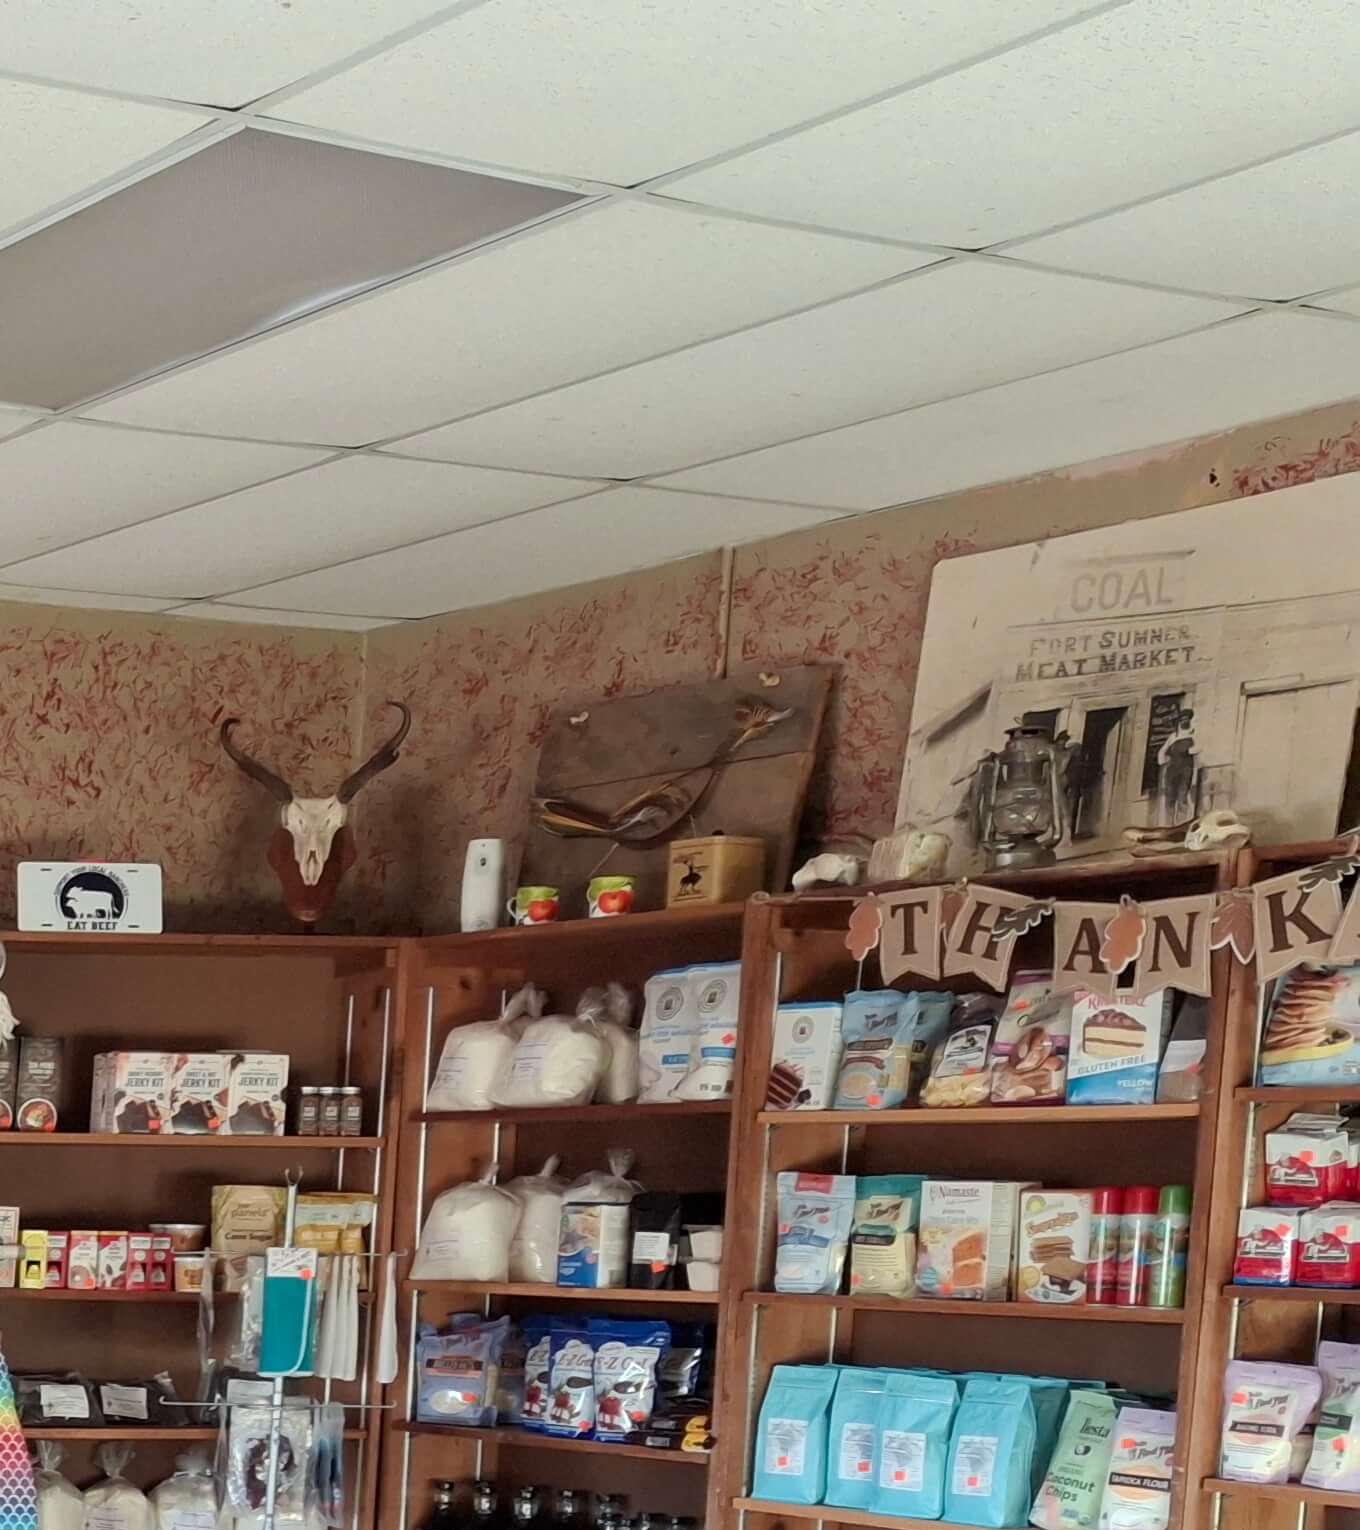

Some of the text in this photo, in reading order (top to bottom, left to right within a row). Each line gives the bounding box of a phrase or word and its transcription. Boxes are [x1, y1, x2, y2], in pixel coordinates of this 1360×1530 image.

[1070, 566, 1175, 614] COAL
[1016, 657, 1088, 682] MEAT
[67, 921, 118, 931] EAT BEEF
[1078, 1062, 1118, 1074] GLUTEN
[126, 1078, 164, 1088] JERKY KIT
[181, 1079, 222, 1089] JERKY KIT
[239, 1077, 279, 1087] JERKY KIT
[938, 1187, 979, 1197] Namaste
[1046, 1472, 1096, 1492] Coconut
[1046, 1485, 1079, 1502] Chips
